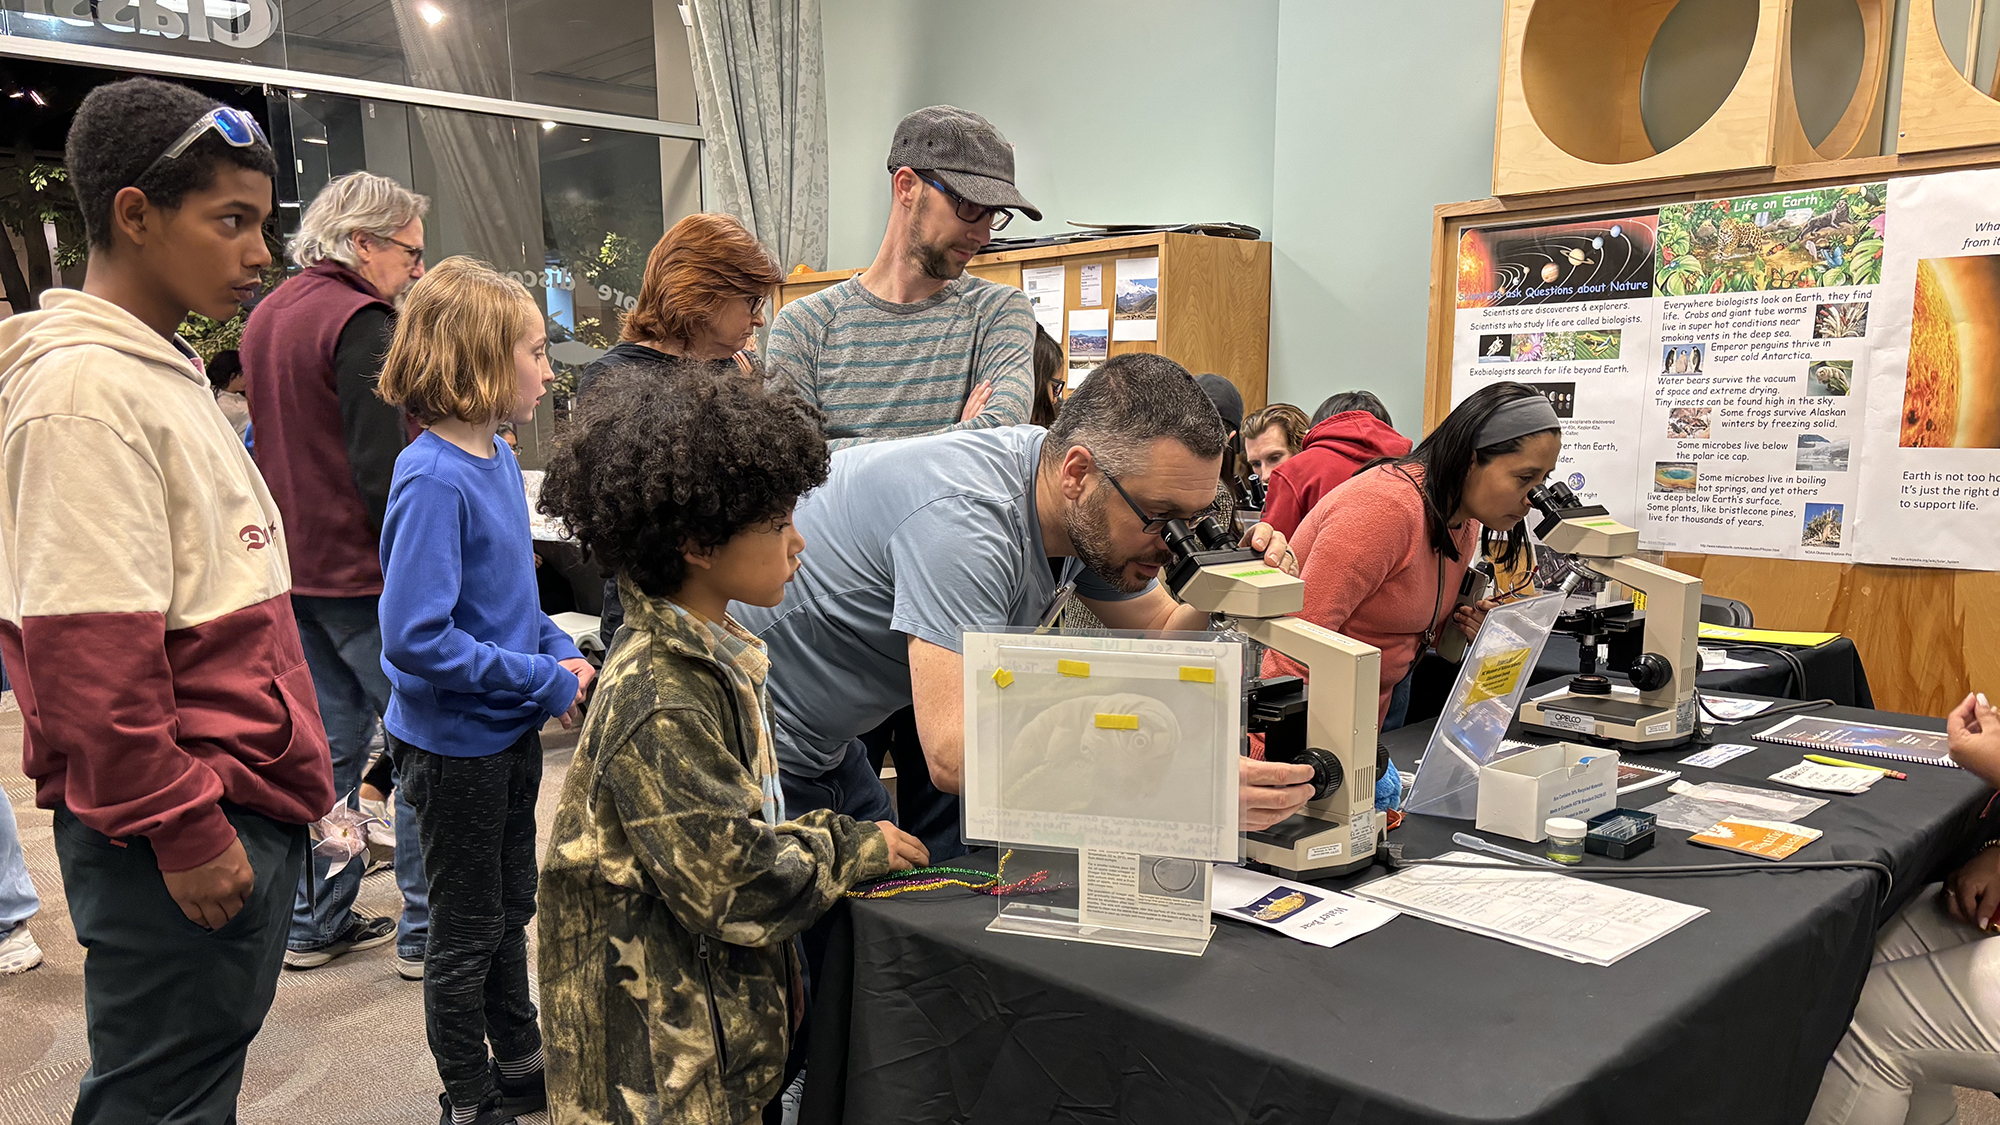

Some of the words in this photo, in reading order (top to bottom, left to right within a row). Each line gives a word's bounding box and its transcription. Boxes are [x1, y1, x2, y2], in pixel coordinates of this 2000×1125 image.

[1734, 198, 1758, 212] Life
[1762, 200, 1777, 209] on
[1782, 194, 1817, 208] Earth
[1961, 238, 1989, 250] from
[1458, 290, 1502, 301] Scientists
[1506, 289, 1522, 298] ask
[1525, 286, 1573, 298] Questions
[1577, 283, 1606, 293] about
[1610, 280, 1648, 292] Nature
[1664, 299, 1713, 312] Everywhere
[1716, 296, 1758, 309] biologists
[1761, 294, 1780, 304] look
[1796, 292, 1825, 303] Earth,
[1828, 291, 1849, 303] they
[1852, 290, 1872, 300] find
[1483, 308, 1519, 317] Scientists
[1536, 305, 1579, 314] discoverers
[1589, 302, 1630, 312] explorers.
[1663, 312, 1680, 321] life.
[1685, 309, 1710, 319] Crabs
[1712, 308, 1727, 318] and
[1730, 307, 1752, 319] giant
[1755, 306, 1775, 316] tube
[1778, 305, 1807, 314] worms
[1470, 322, 1506, 330] Scientists
[1524, 319, 1544, 329] study
[1546, 317, 1559, 327] life
[1577, 316, 1600, 325] called
[1602, 314, 1642, 326] biologists.
[1662, 322, 1677, 331] live
[1678, 322, 1687, 330] in
[1688, 322, 1712, 332] super
[1715, 319, 1729, 329] hot
[1732, 318, 1777, 328] conditions
[1780, 318, 1800, 326] near
[1661, 333, 1694, 344] smoking
[1696, 332, 1720, 341] vents
[1722, 332, 1730, 340] in
[1733, 330, 1747, 339] the
[1750, 329, 1772, 340] deep
[1774, 330, 1791, 338] sea.
[1711, 342, 1748, 353] Emperor
[1751, 341, 1788, 353] penguins
[1792, 339, 1820, 348] thrive
[1714, 354, 1738, 363] super
[1741, 352, 1759, 361] cold
[1761, 350, 1812, 360] Antarctica.
[1470, 367, 1516, 377] Exobiologists
[1518, 366, 1540, 375] search
[1544, 366, 1556, 375] for
[1559, 365, 1571, 374] life
[1574, 365, 1601, 375] beyond
[1604, 364, 1629, 373] Earth.
[1658, 377, 1684, 385] Water
[1687, 376, 1710, 384] bears
[1712, 376, 1743, 384] survive
[1746, 374, 1761, 383] the
[1764, 375, 1796, 383] vacuum
[1656, 387, 1665, 396] of
[1667, 388, 1691, 397] space
[1693, 386, 1708, 395] and
[1710, 385, 1747, 394] extreme
[1749, 385, 1780, 397] drying.
[1655, 398, 1672, 408] Tiny
[1675, 397, 1704, 406] insects
[1707, 398, 1721, 406] can
[1724, 397, 1734, 406] be
[1738, 397, 1762, 406] found
[1765, 396, 1785, 408] high
[1788, 397, 1796, 405] in
[1799, 396, 1814, 405] the
[1817, 396, 1835, 408] sky.
[1720, 408, 1744, 417] Some
[1747, 408, 1771, 419] frogs
[1809, 408, 1846, 416] Alaskan
[1721, 419, 1755, 428] winters
[1757, 419, 1769, 430] by
[1772, 419, 1810, 430] freezing
[1813, 418, 1838, 428] solid.
[1593, 442, 1618, 451] Earth,
[1677, 441, 1700, 449] Some
[1702, 442, 1741, 450] microbes
[1744, 442, 1759, 450] live
[1762, 442, 1788, 450] below
[1676, 451, 1690, 460] the
[1693, 452, 1715, 462] polar
[1717, 452, 1730, 460] ice
[1732, 453, 1749, 462] cap.
[1698, 474, 1722, 482] Some
[1725, 474, 1765, 483] microbes
[1768, 475, 1783, 483] live
[1786, 475, 1794, 483] in
[1796, 475, 1826, 486] boiling
[1903, 471, 1931, 481] Earth
[1934, 472, 1942, 481] is
[1946, 473, 1964, 481] not
[1967, 473, 1985, 482] too
[1698, 484, 1712, 492] hot
[1715, 485, 1749, 495] springs,
[1751, 485, 1767, 494] and
[1769, 487, 1784, 496] yet
[1787, 487, 1818, 495] others
[1919, 486, 1940, 496] just
[1943, 486, 1960, 496] the
[1964, 486, 1990, 498] right
[1647, 493, 1661, 501] live
[1663, 493, 1684, 502] deep
[1686, 494, 1710, 502] below
[1712, 495, 1743, 504] Earth's
[1746, 496, 1782, 505] surface.
[1900, 499, 1910, 508] to
[1914, 500, 1956, 511] support
[1959, 500, 1979, 510] life.
[1647, 504, 1669, 512] Some
[1672, 504, 1699, 514] plants,
[1702, 505, 1716, 513] like
[1719, 506, 1768, 516] bristlecone
[1771, 508, 1796, 518] pines,
[1648, 513, 1663, 522] live
[1665, 514, 1679, 522] for
[1682, 515, 1723, 524] thousands
[1726, 517, 1735, 525] of
[1738, 518, 1764, 528] years.
[1555, 713, 1582, 724] OPELCO
